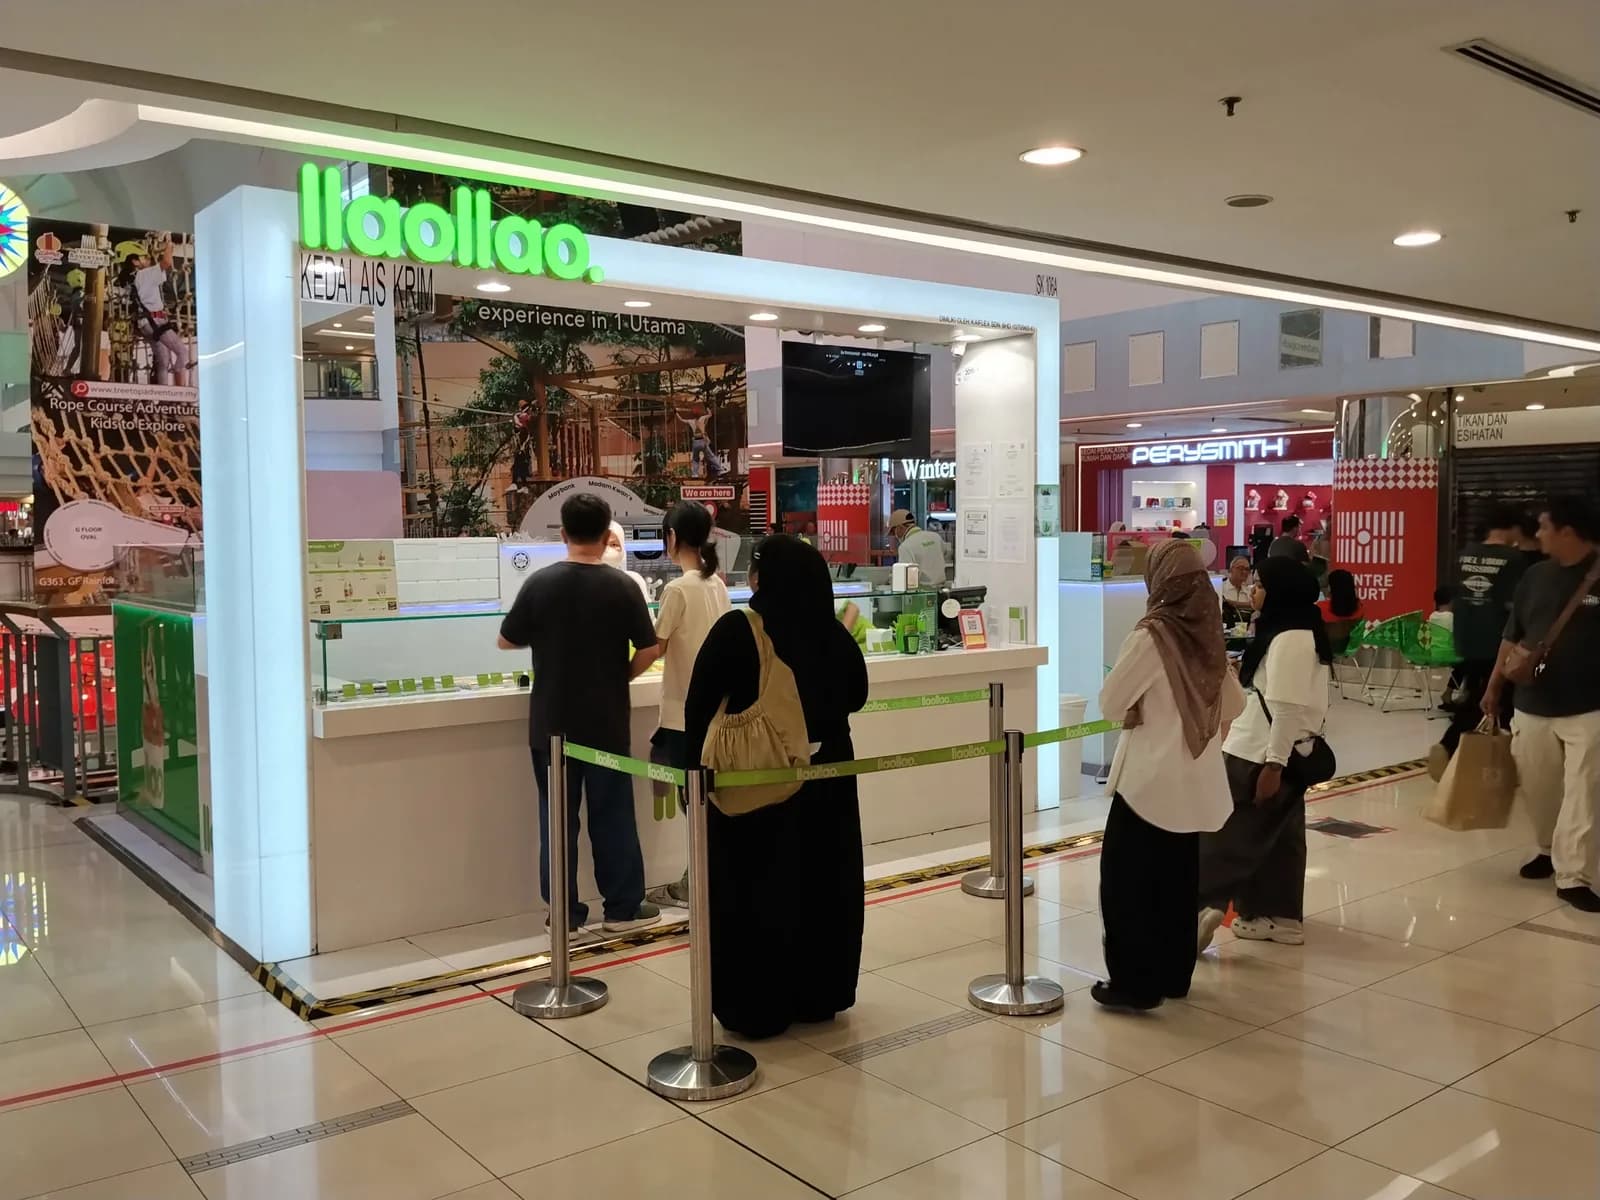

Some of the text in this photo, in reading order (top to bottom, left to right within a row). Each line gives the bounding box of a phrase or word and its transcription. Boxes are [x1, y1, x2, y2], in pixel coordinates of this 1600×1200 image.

[301, 253, 434, 313] KEDAI AIS KRIM
[478, 306, 585, 328] experience
[591, 311, 607, 329] in
[629, 314, 686, 335] Utama
[50, 398, 84, 411] Rope
[88, 400, 133, 413] Course
[91, 417, 185, 432] Kids to Explore
[1487, 413, 1509, 426] DAN
[901, 458, 957, 480] Winter
[547, 482, 576, 500] Maybank
[588, 480, 612, 489] Madam
[685, 489, 698, 497] We
[713, 488, 731, 497] here
[1353, 574, 1393, 587] NTRE
[1355, 588, 1388, 600] URT
